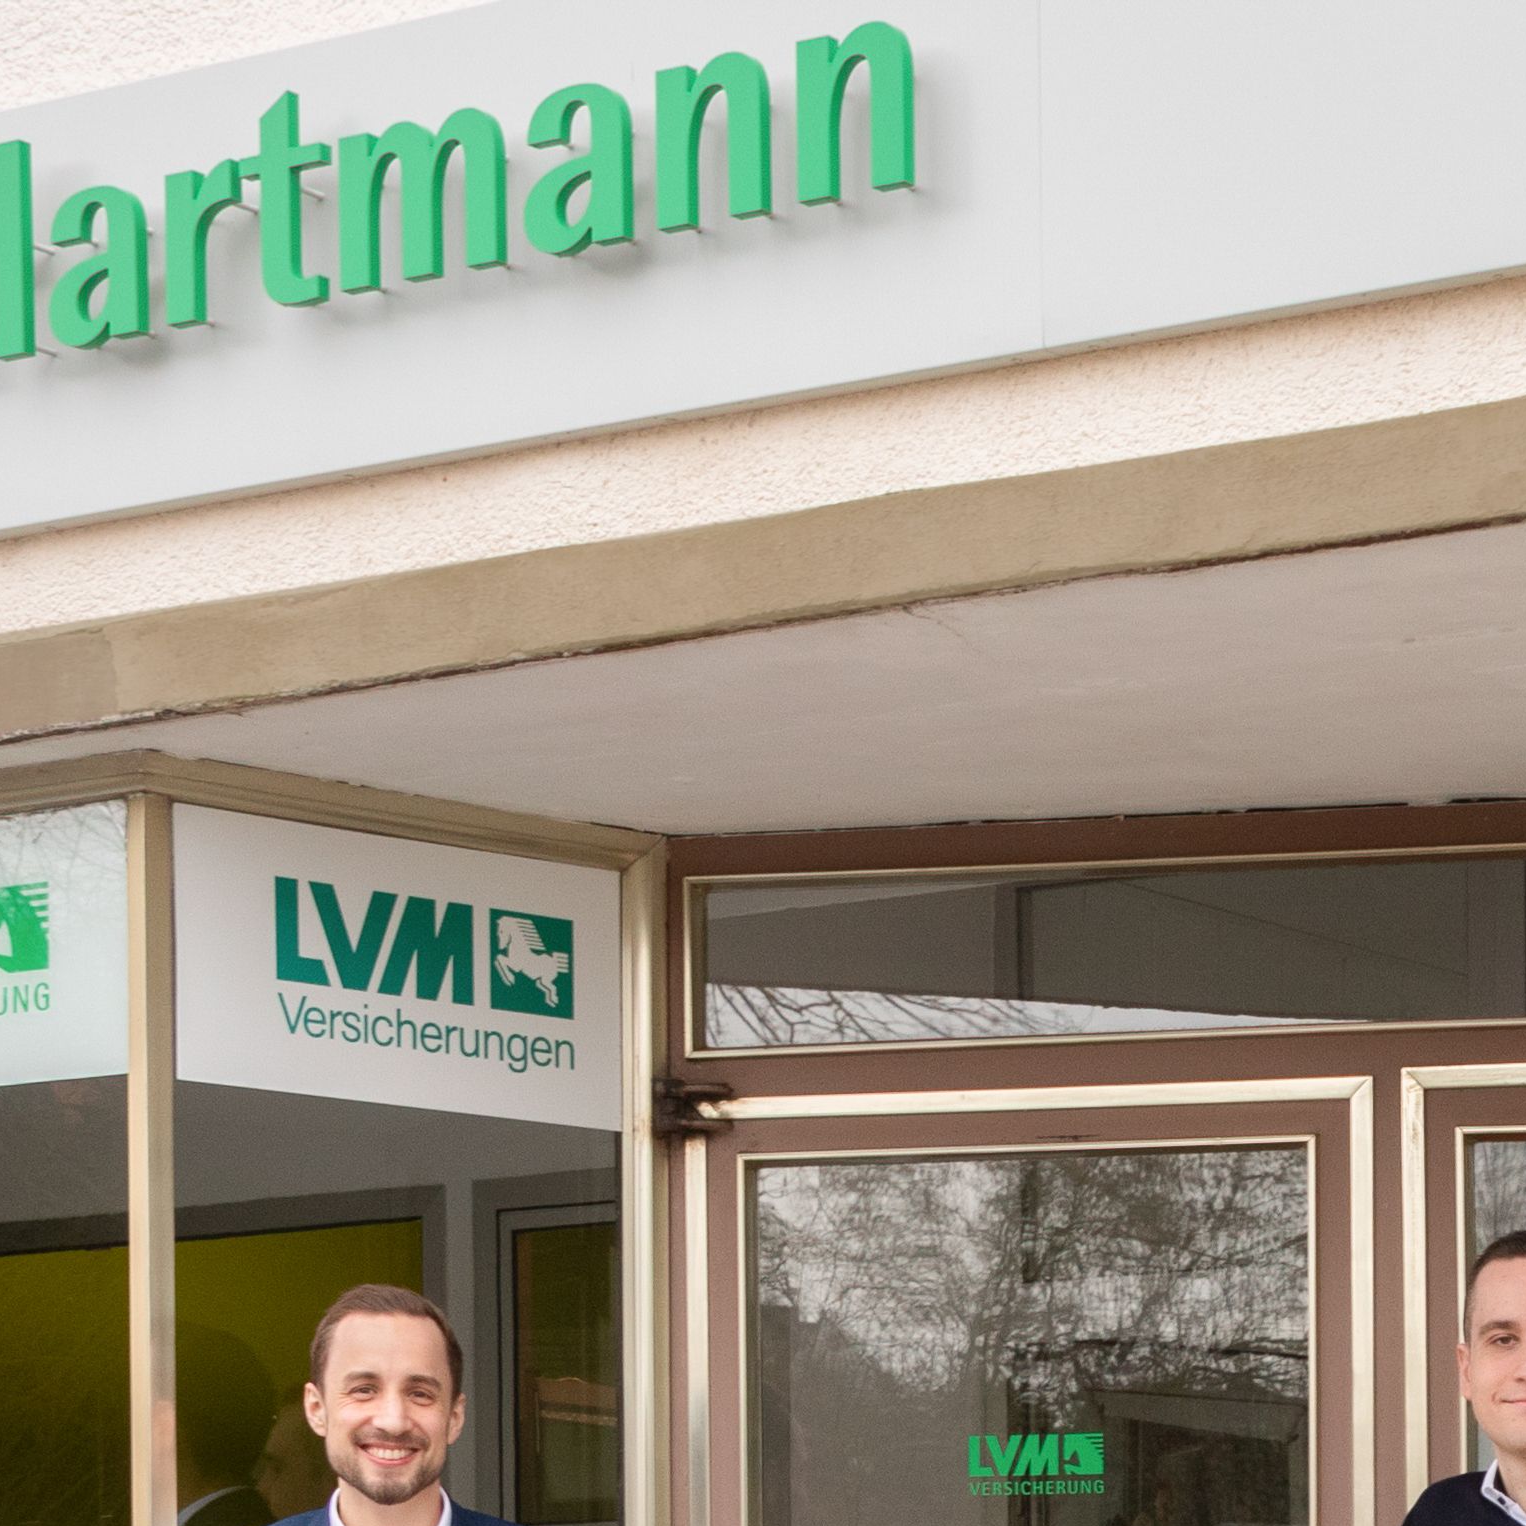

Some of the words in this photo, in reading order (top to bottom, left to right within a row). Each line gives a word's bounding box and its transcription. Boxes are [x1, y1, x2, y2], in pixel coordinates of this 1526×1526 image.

[274, 875, 474, 1006] LVM
[278, 991, 575, 1073] Versicherungen
[968, 1434, 1059, 1478] LVM
[968, 1479, 1105, 1496] VERSICHERUNG
